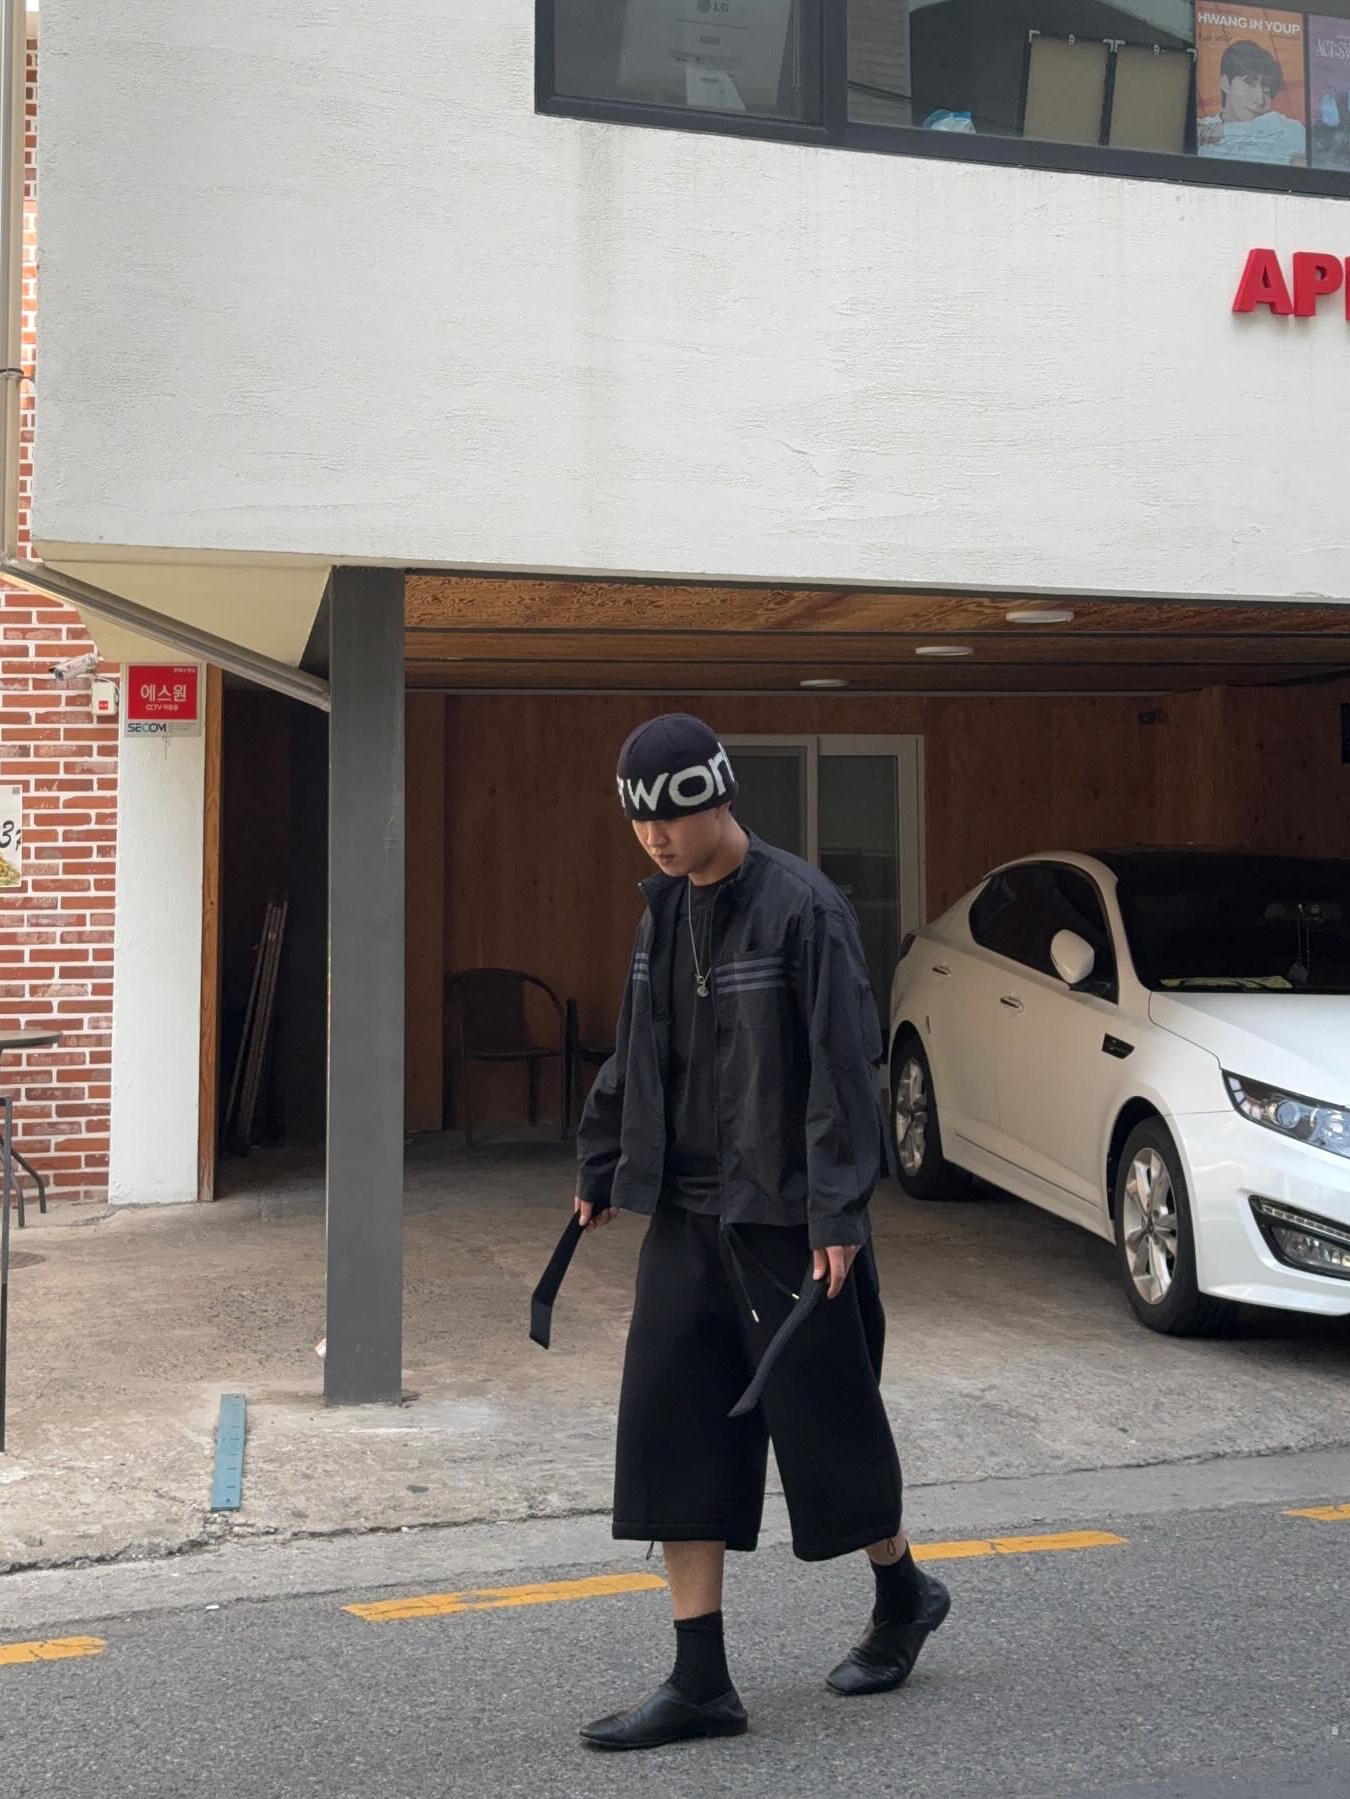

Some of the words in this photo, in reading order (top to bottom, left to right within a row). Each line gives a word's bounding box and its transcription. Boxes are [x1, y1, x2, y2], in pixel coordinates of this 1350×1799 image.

[714, 2, 730, 13] LG
[1198, 12, 1248, 28] HWANG
[1250, 16, 1263, 30] IN
[1266, 20, 1301, 35] YOUP
[1232, 248, 1350, 321] AP
[140, 684, 187, 703] 에스원
[145, 703, 162, 712] CCTV
[127, 722, 167, 733] SECOM
[616, 741, 735, 811] wor
